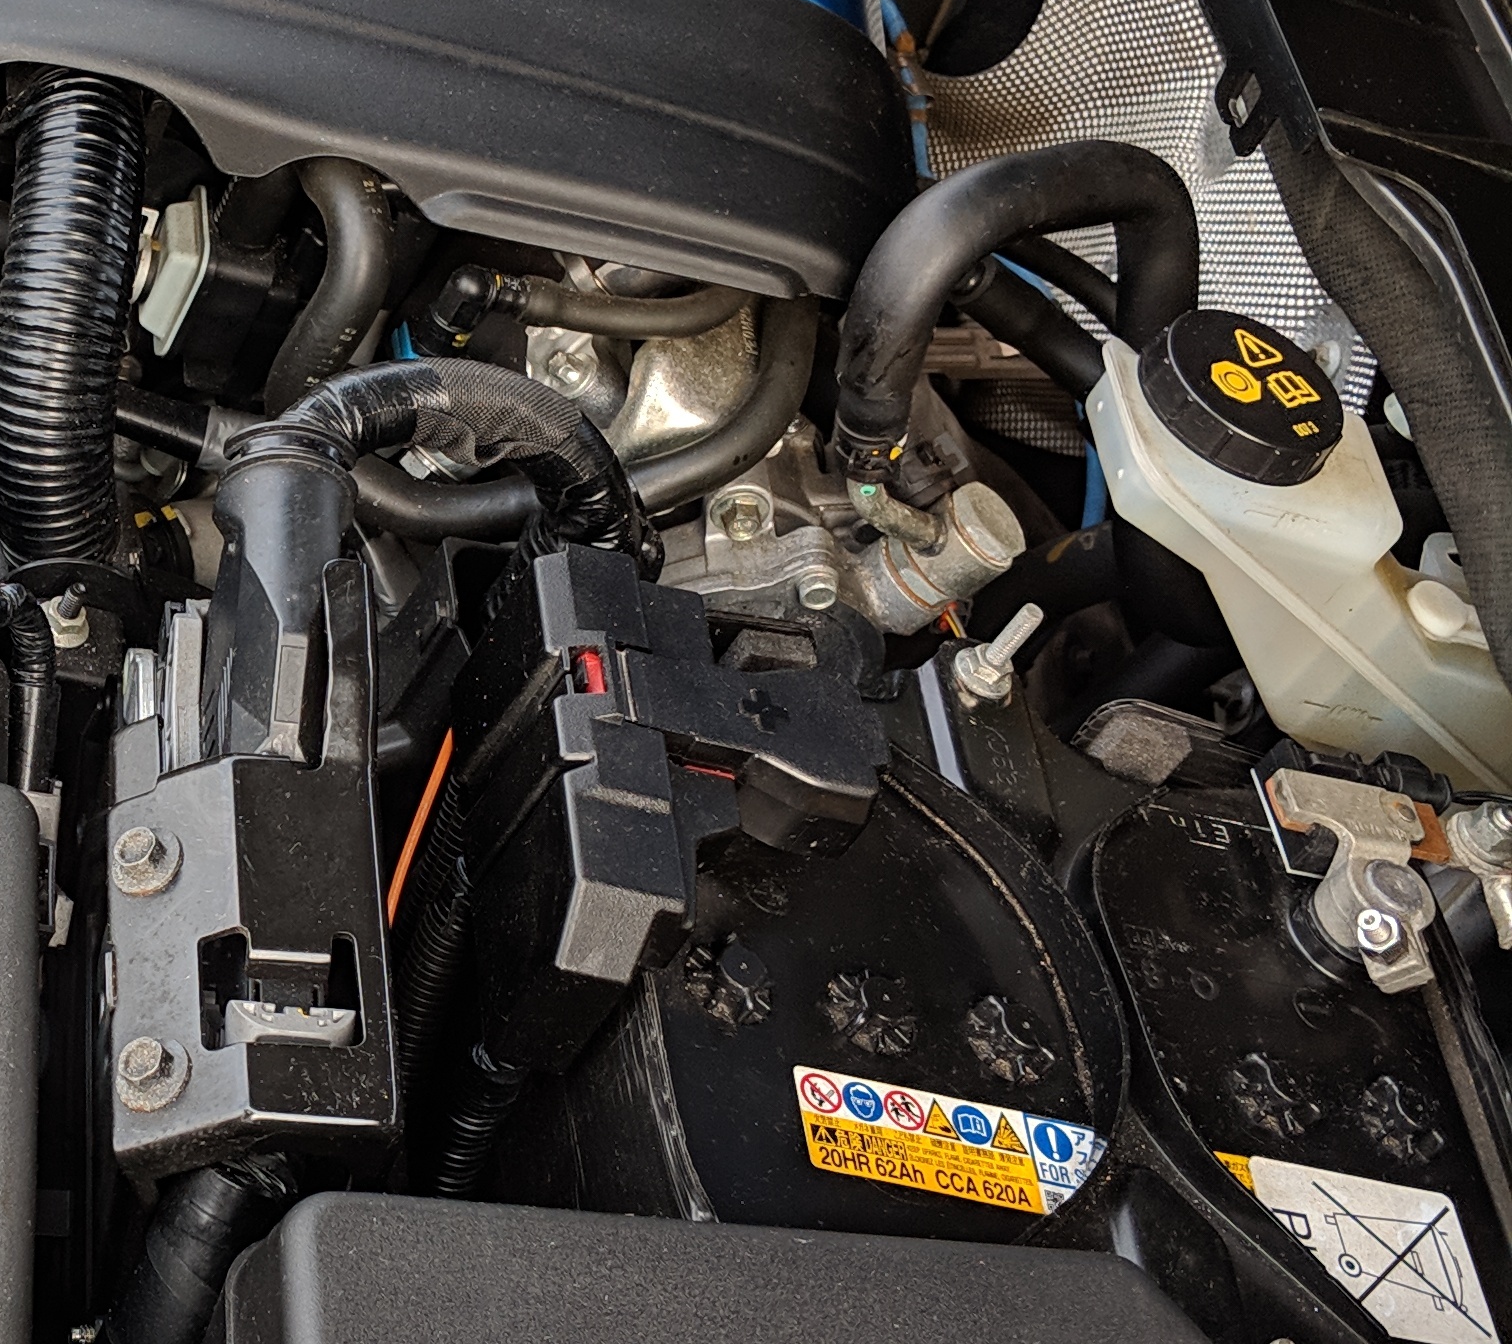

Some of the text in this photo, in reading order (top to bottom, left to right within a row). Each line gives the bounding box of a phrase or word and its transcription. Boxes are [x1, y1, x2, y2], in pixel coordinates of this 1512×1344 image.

[864, 1136, 909, 1161] DANGER
[819, 1146, 871, 1174] 20HR
[875, 1158, 925, 1184] 62Ah
[935, 1169, 979, 1197] CCA
[983, 1182, 1032, 1207] 620A
[1039, 1161, 1071, 1184] FOR
